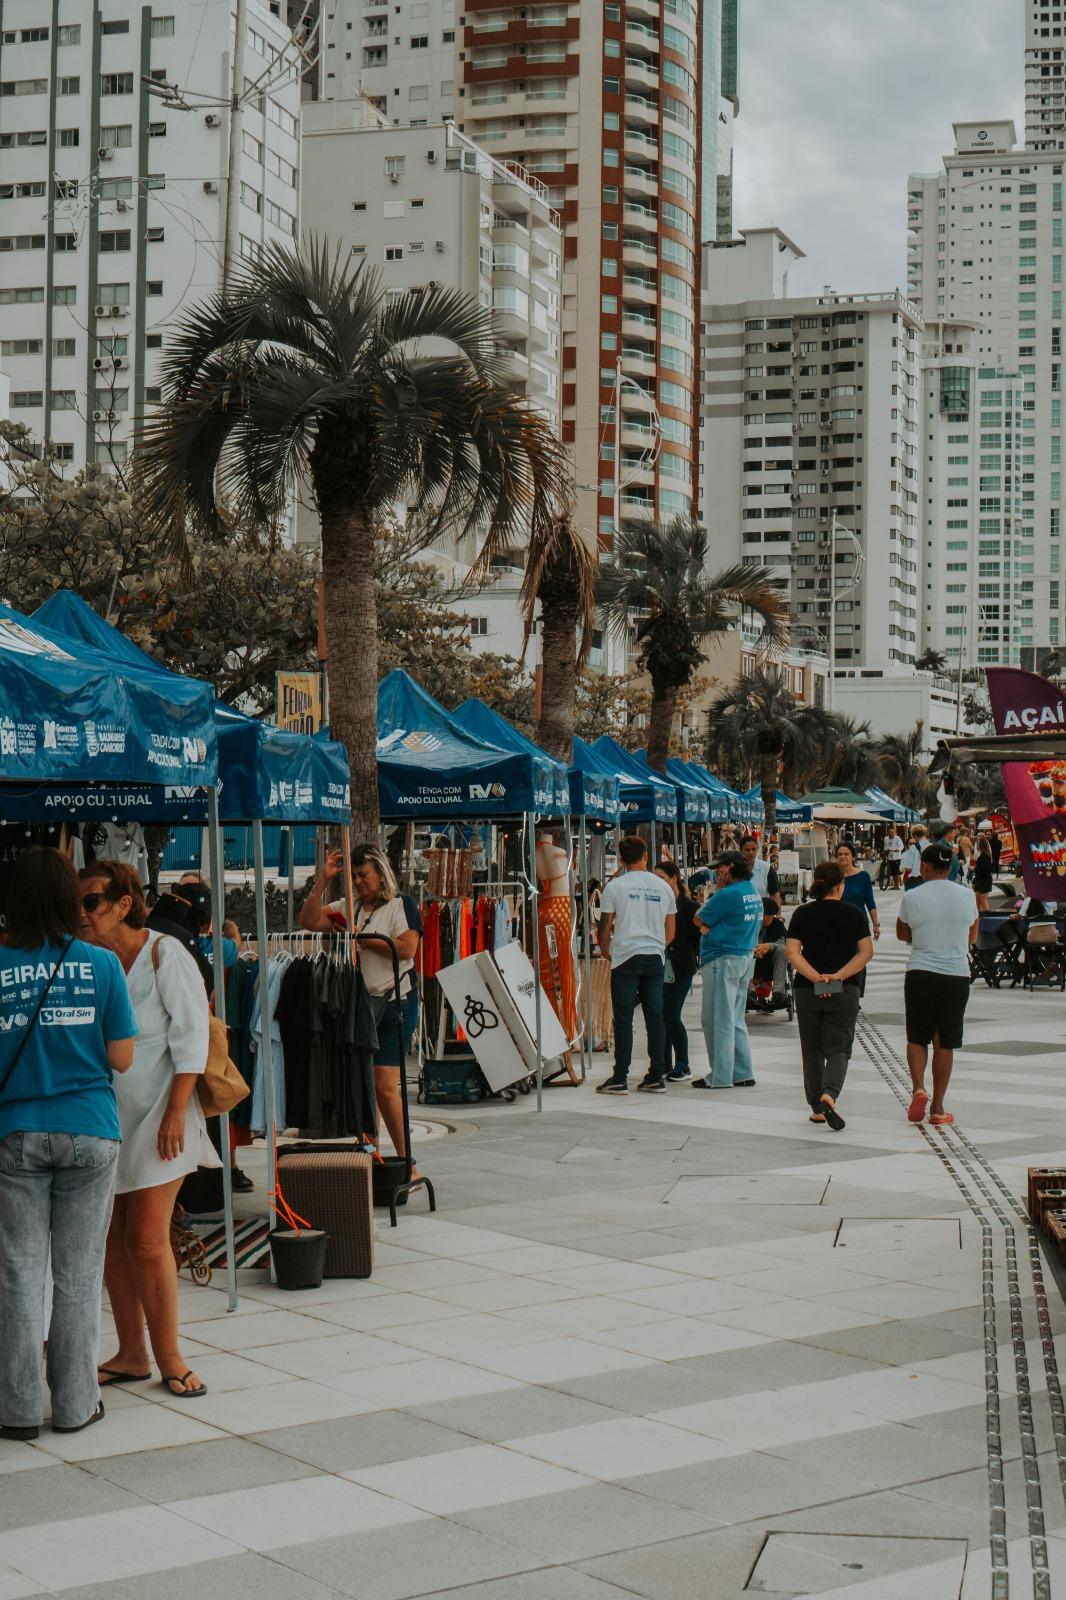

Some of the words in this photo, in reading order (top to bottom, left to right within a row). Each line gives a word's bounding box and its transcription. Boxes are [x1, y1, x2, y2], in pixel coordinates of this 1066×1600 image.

[1004, 700, 1065, 731] AÇAÍ
[418, 786, 442, 794] TENDA
[443, 786, 461, 794] COM
[44, 795, 85, 807] APOIO
[398, 796, 422, 804] APOIO
[423, 796, 463, 804] CULTURAL
[56, 1010, 74, 1018] Oral
